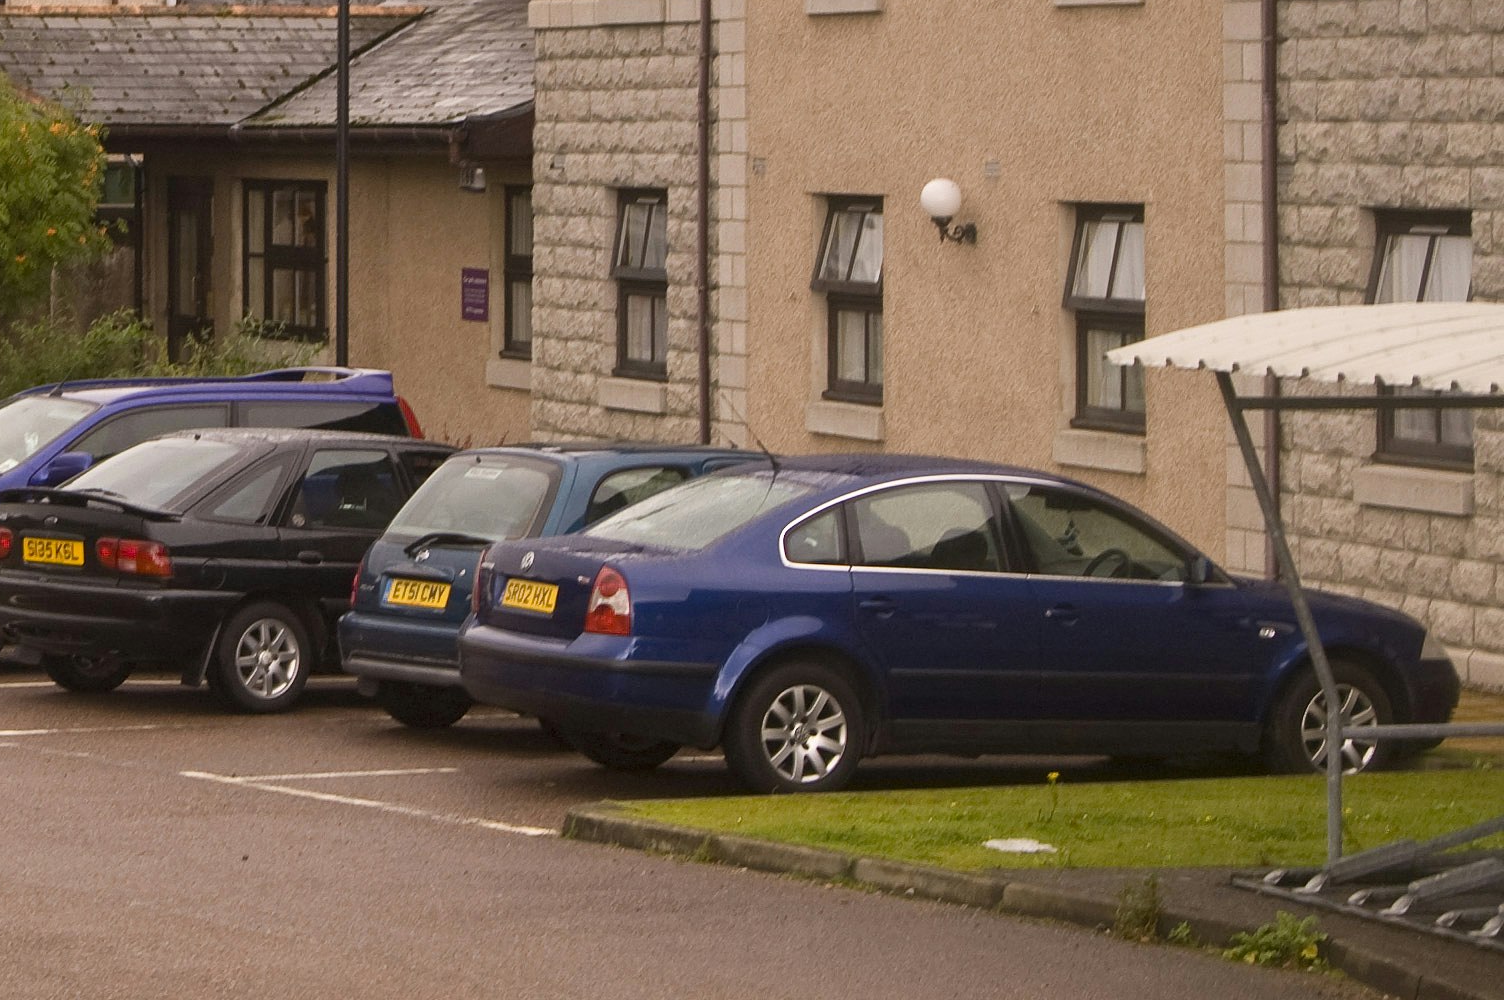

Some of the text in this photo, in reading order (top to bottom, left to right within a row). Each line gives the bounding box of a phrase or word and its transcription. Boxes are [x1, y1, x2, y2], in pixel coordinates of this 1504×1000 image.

[392, 581, 446, 603] ET51 CMY
[505, 582, 554, 608] SR02 HXL
